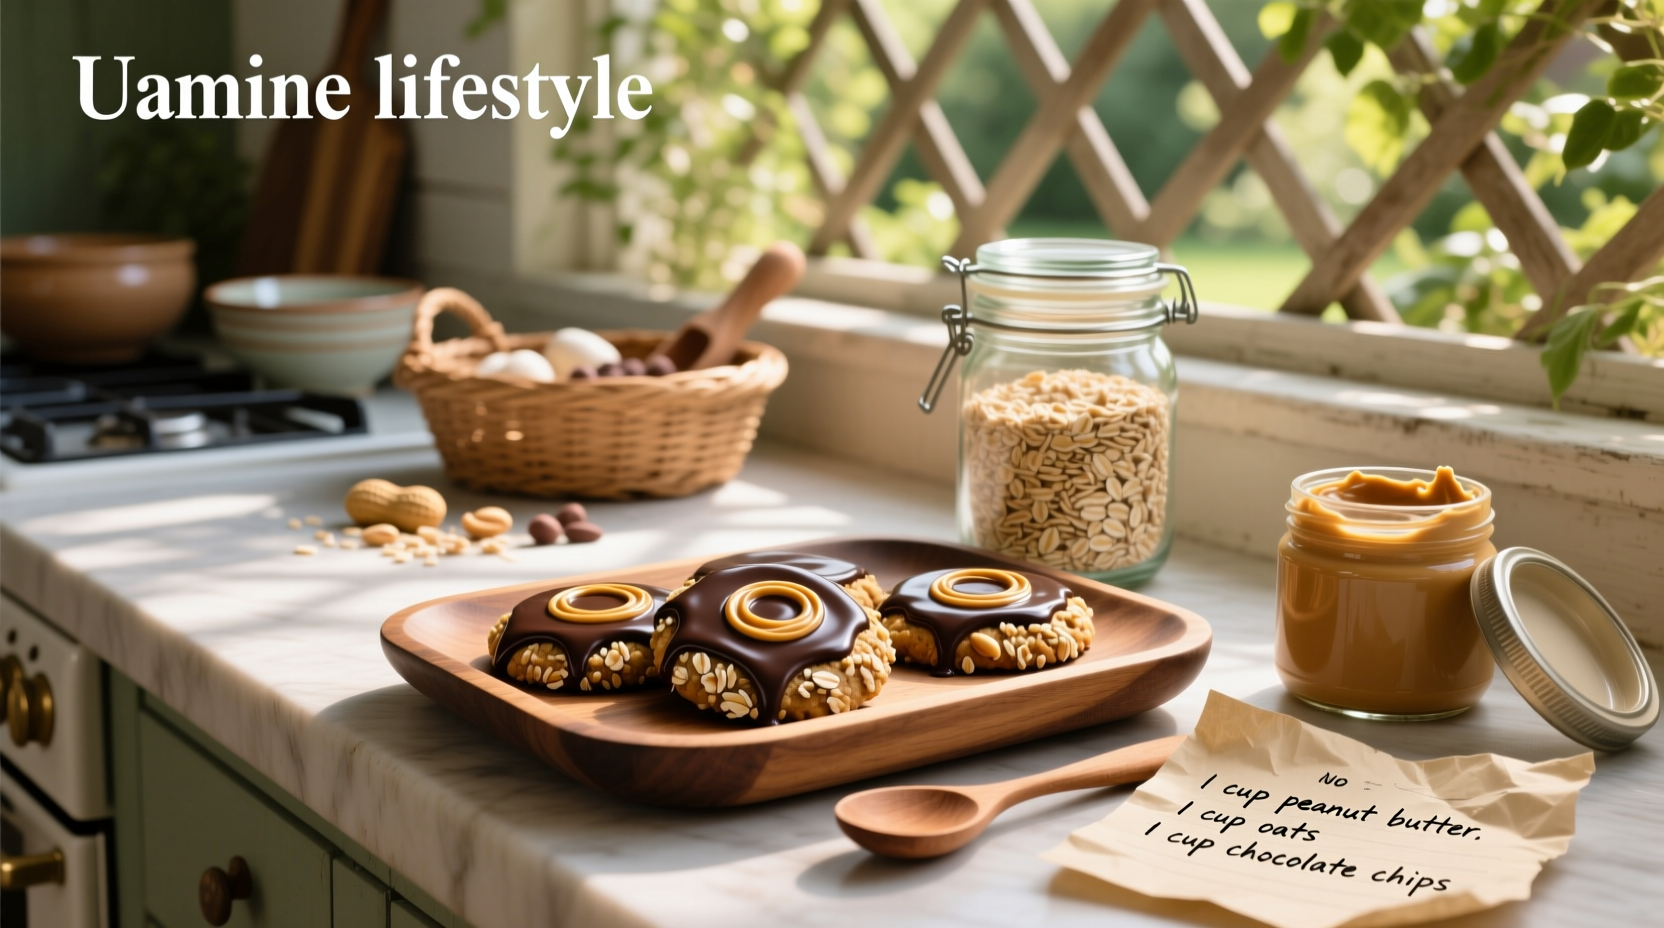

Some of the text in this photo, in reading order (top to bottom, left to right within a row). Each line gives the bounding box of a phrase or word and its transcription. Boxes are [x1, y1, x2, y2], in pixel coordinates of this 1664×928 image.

[1200, 810, 1246, 834] cup
[1258, 823, 1320, 842] oats
[1222, 784, 1270, 809] cup
[1273, 795, 1378, 822] peanut
[1386, 807, 1481, 841] butter.
[1167, 832, 1215, 857] cup
[1226, 841, 1357, 878] chocolate
[1371, 866, 1451, 897] chips
